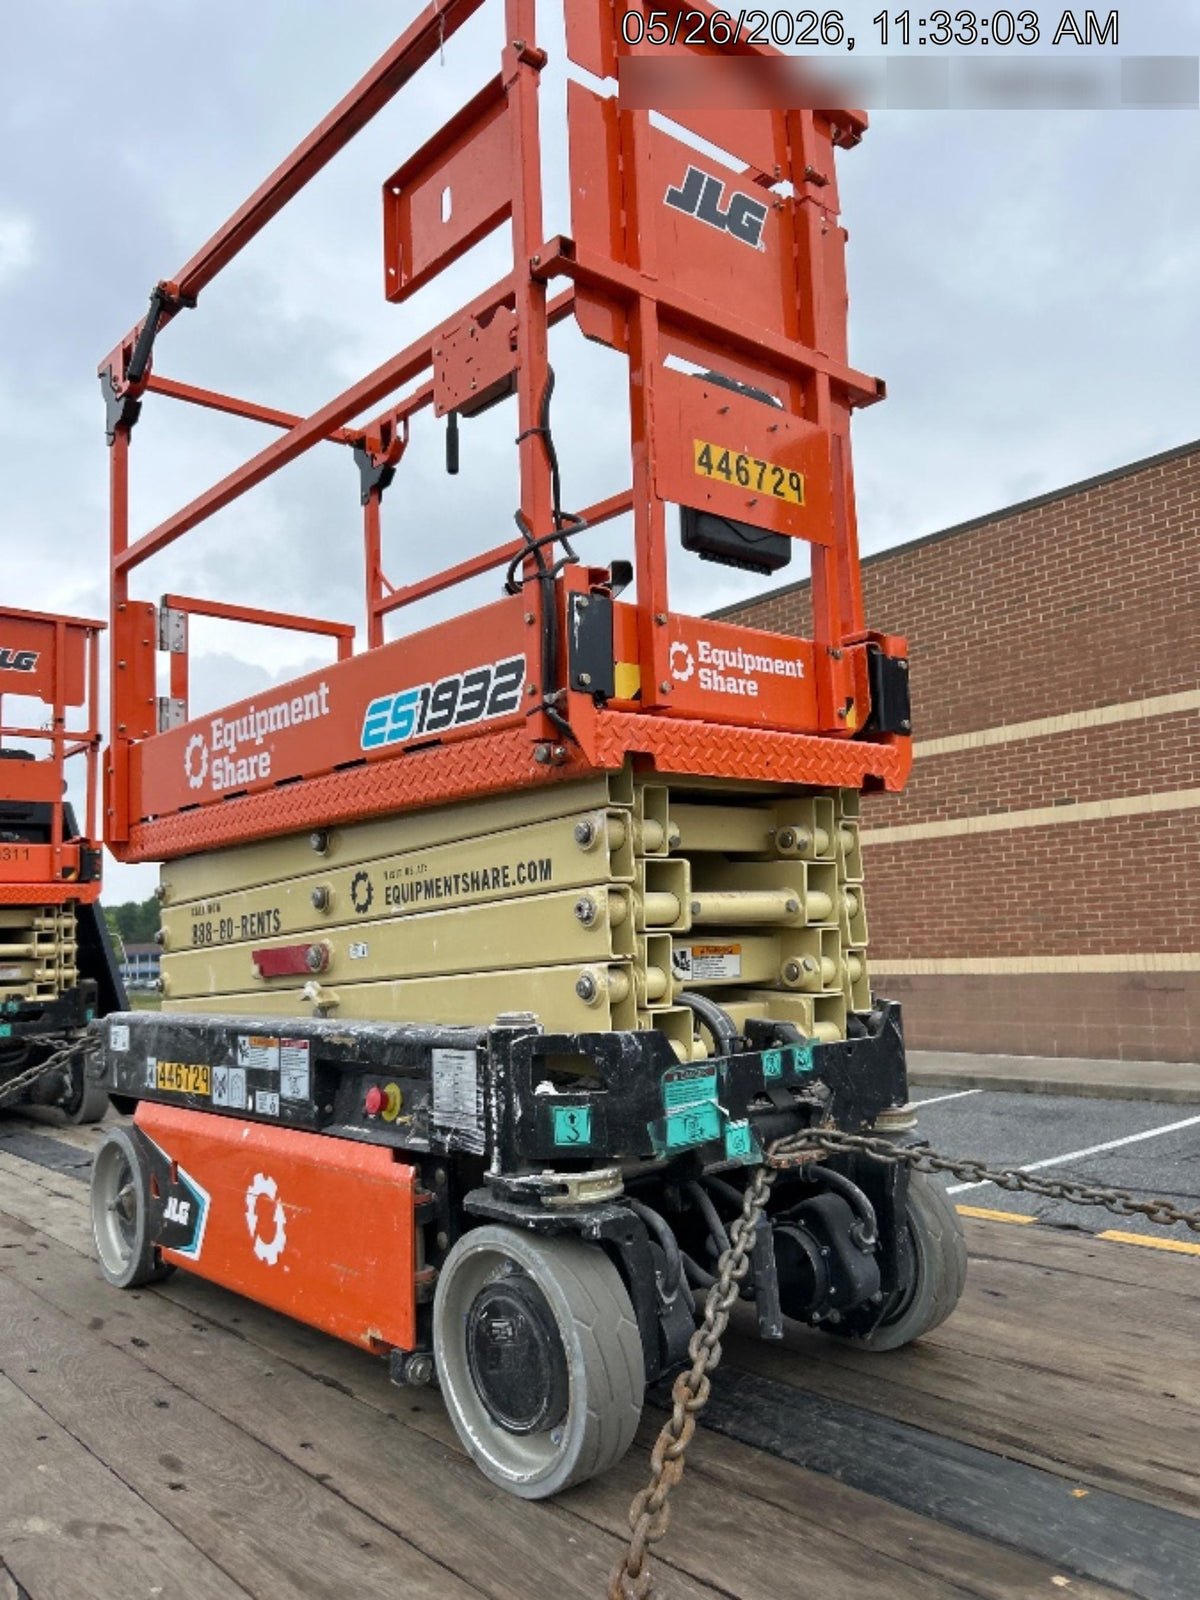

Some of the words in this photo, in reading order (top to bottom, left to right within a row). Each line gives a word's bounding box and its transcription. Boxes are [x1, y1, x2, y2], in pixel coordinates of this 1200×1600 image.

[662, 164, 769, 251] JLG
[697, 443, 802, 503] 446729
[697, 640, 804, 678] Equipment
[698, 667, 758, 696] Share
[211, 682, 329, 754] Equipment
[361, 652, 526, 751] ES1932
[211, 752, 271, 791] Share
[385, 858, 552, 905] EQUIPMENTSHARE.COM
[192, 907, 281, 945] 888-80-RENTS
[159, 1062, 209, 1092] 446729
[163, 1195, 191, 1226] JLG
